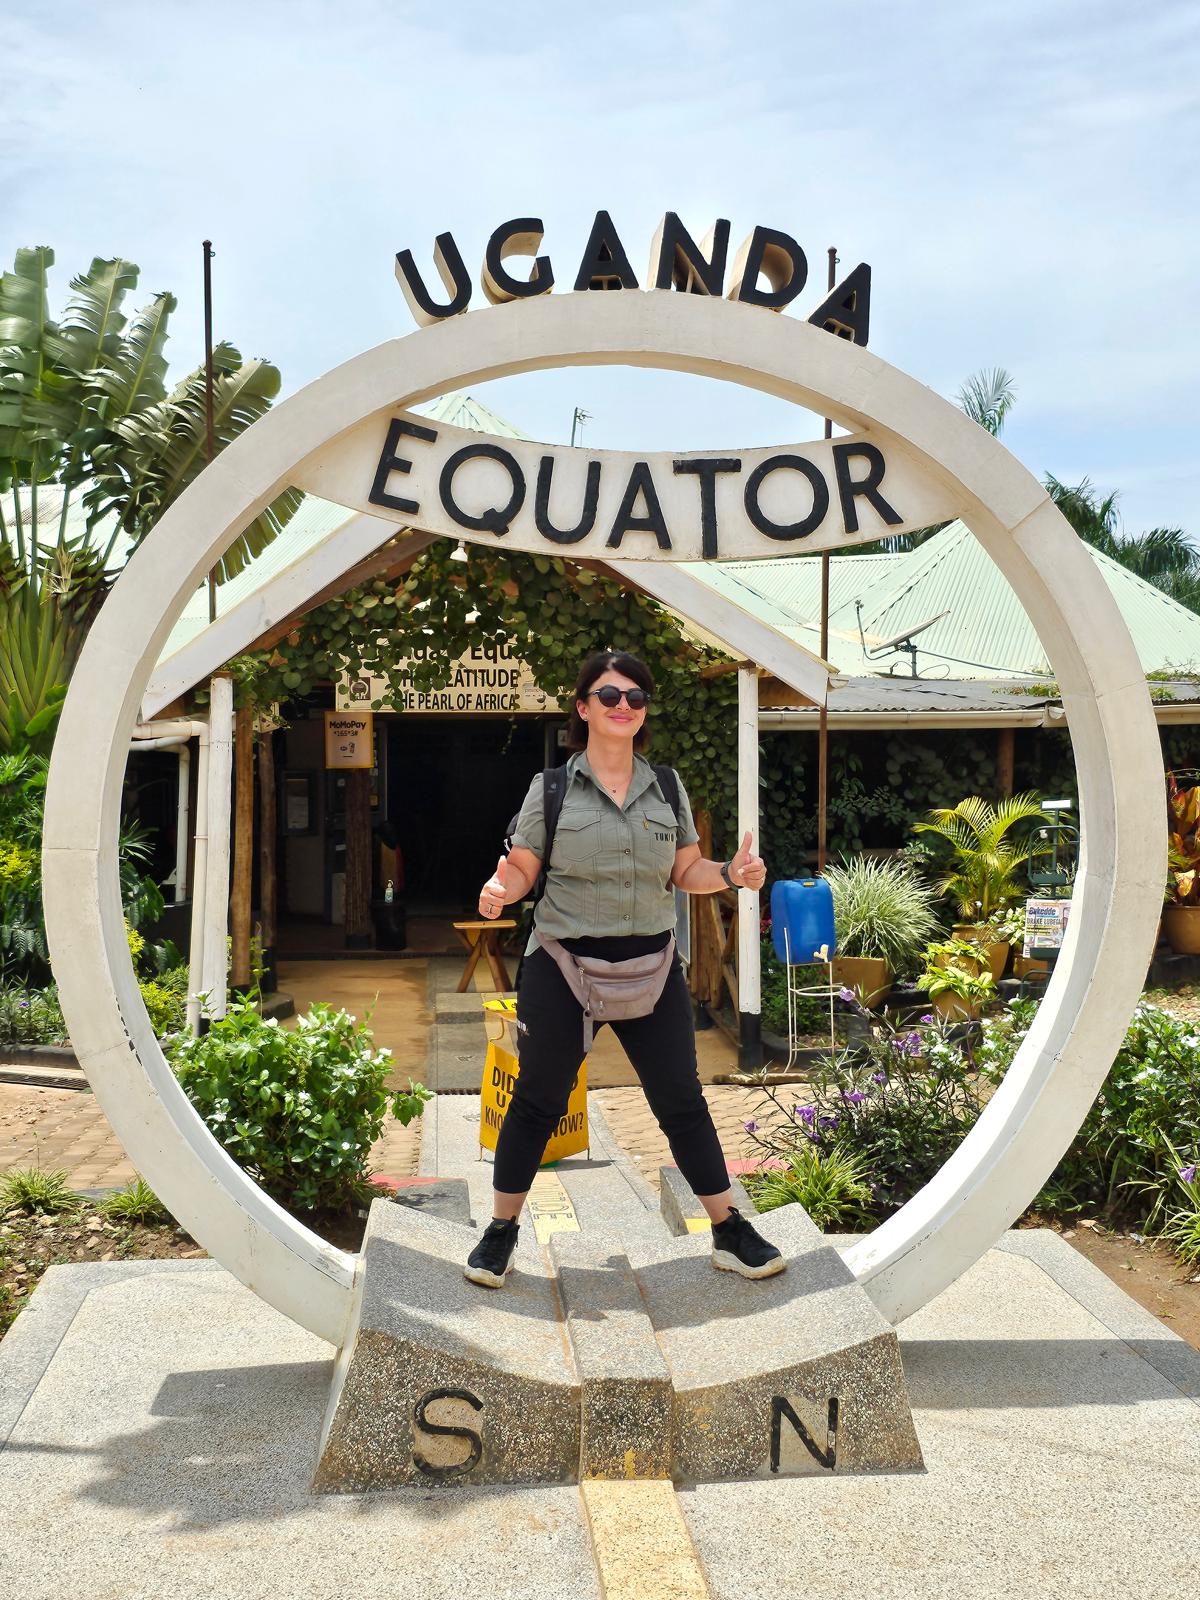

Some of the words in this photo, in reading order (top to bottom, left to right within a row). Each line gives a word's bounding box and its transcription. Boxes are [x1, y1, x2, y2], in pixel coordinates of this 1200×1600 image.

[395, 210, 872, 346] UGANDA
[367, 417, 904, 559] EQUATOR
[329, 720, 367, 731] MoMoPay
[402, 693, 415, 709] HE
[418, 693, 454, 710] PEARL
[457, 693, 474, 709] OF
[475, 693, 517, 710] AFRICA
[492, 1066, 516, 1095] DID
[496, 1091, 507, 1108] U
[413, 1387, 484, 1479] S
[771, 1396, 838, 1473] N
